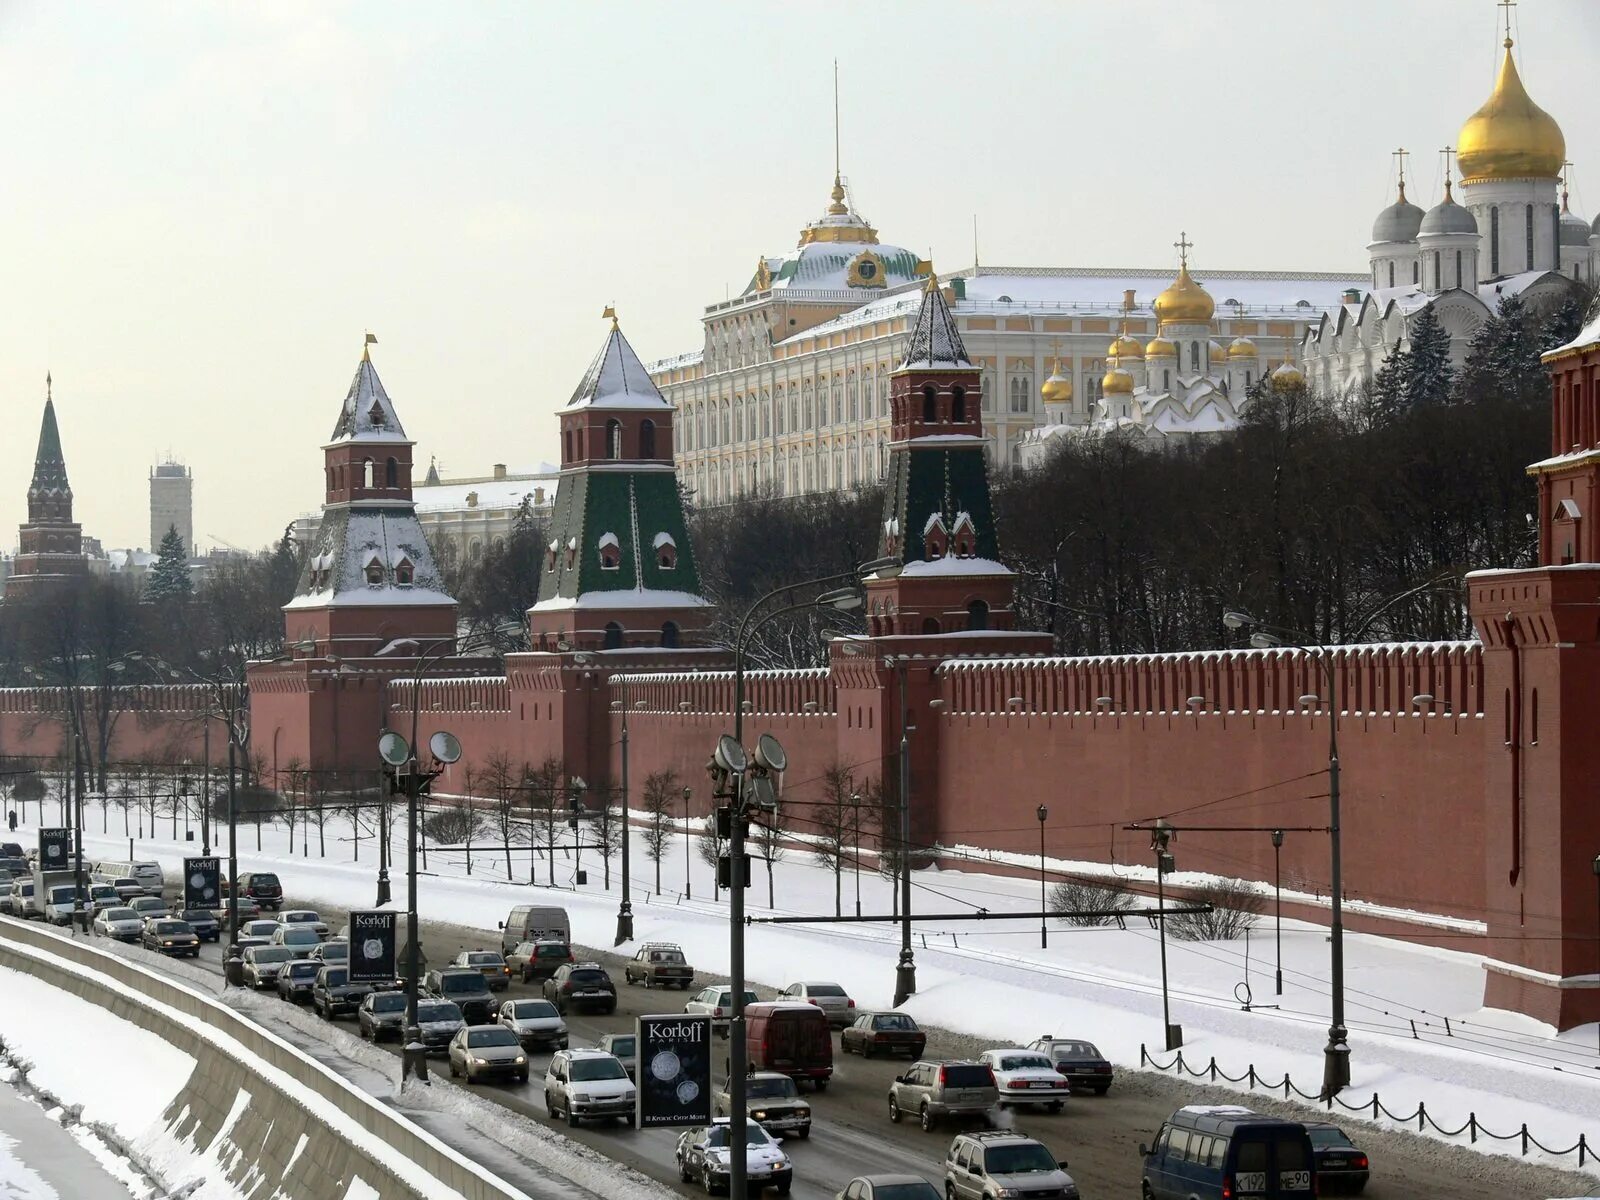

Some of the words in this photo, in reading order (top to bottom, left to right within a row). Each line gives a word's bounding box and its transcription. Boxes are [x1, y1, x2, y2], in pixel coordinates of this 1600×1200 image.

[189, 860, 217, 870] Korloff
[356, 914, 391, 928] Korloff
[649, 1021, 705, 1042] Korloff
